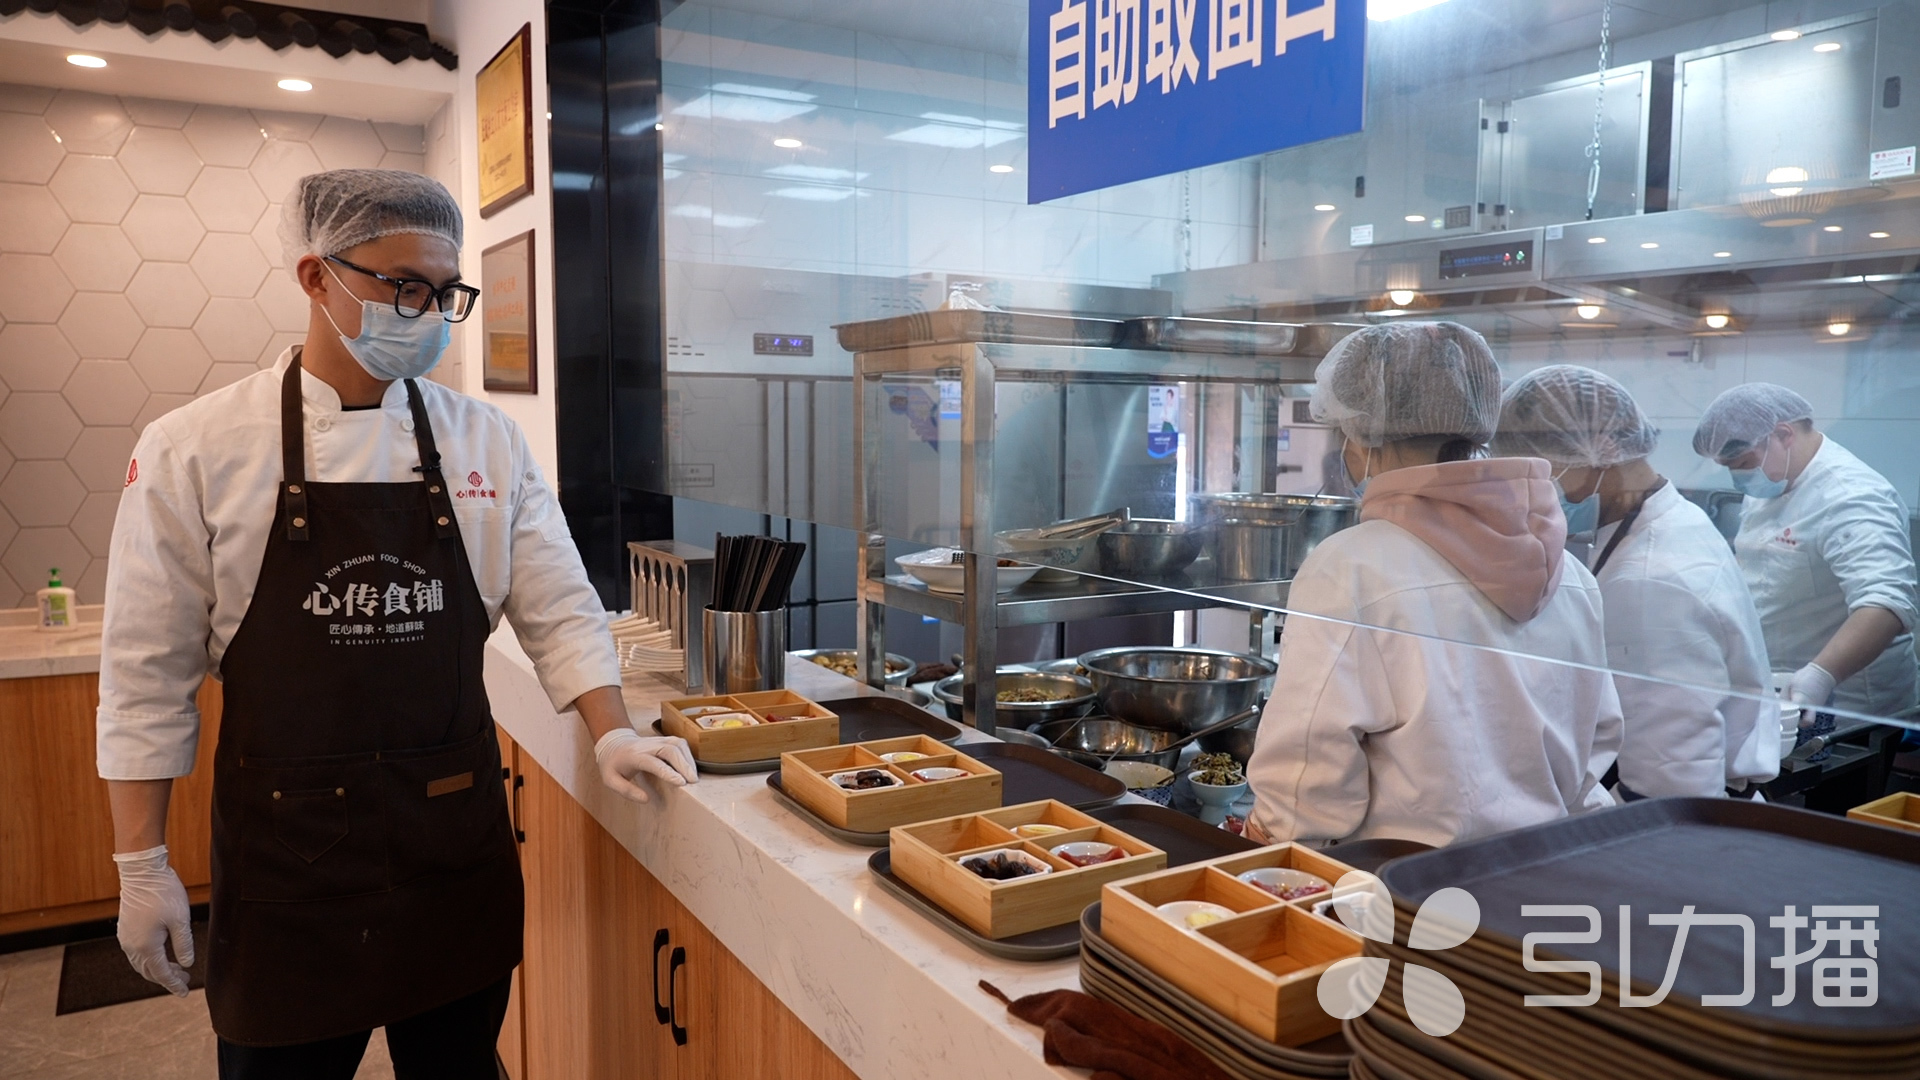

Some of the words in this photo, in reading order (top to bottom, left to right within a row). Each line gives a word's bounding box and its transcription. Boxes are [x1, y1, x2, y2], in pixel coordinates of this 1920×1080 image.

[325, 565, 342, 579] XIN
[342, 554, 375, 569] ZHUAN
[380, 553, 399, 564] FOOD
[402, 560, 427, 575] SHOP
[302, 579, 444, 617] 心传食铺
[346, 638, 386, 646] GENUITY
[390, 635, 425, 644] INHERIT
